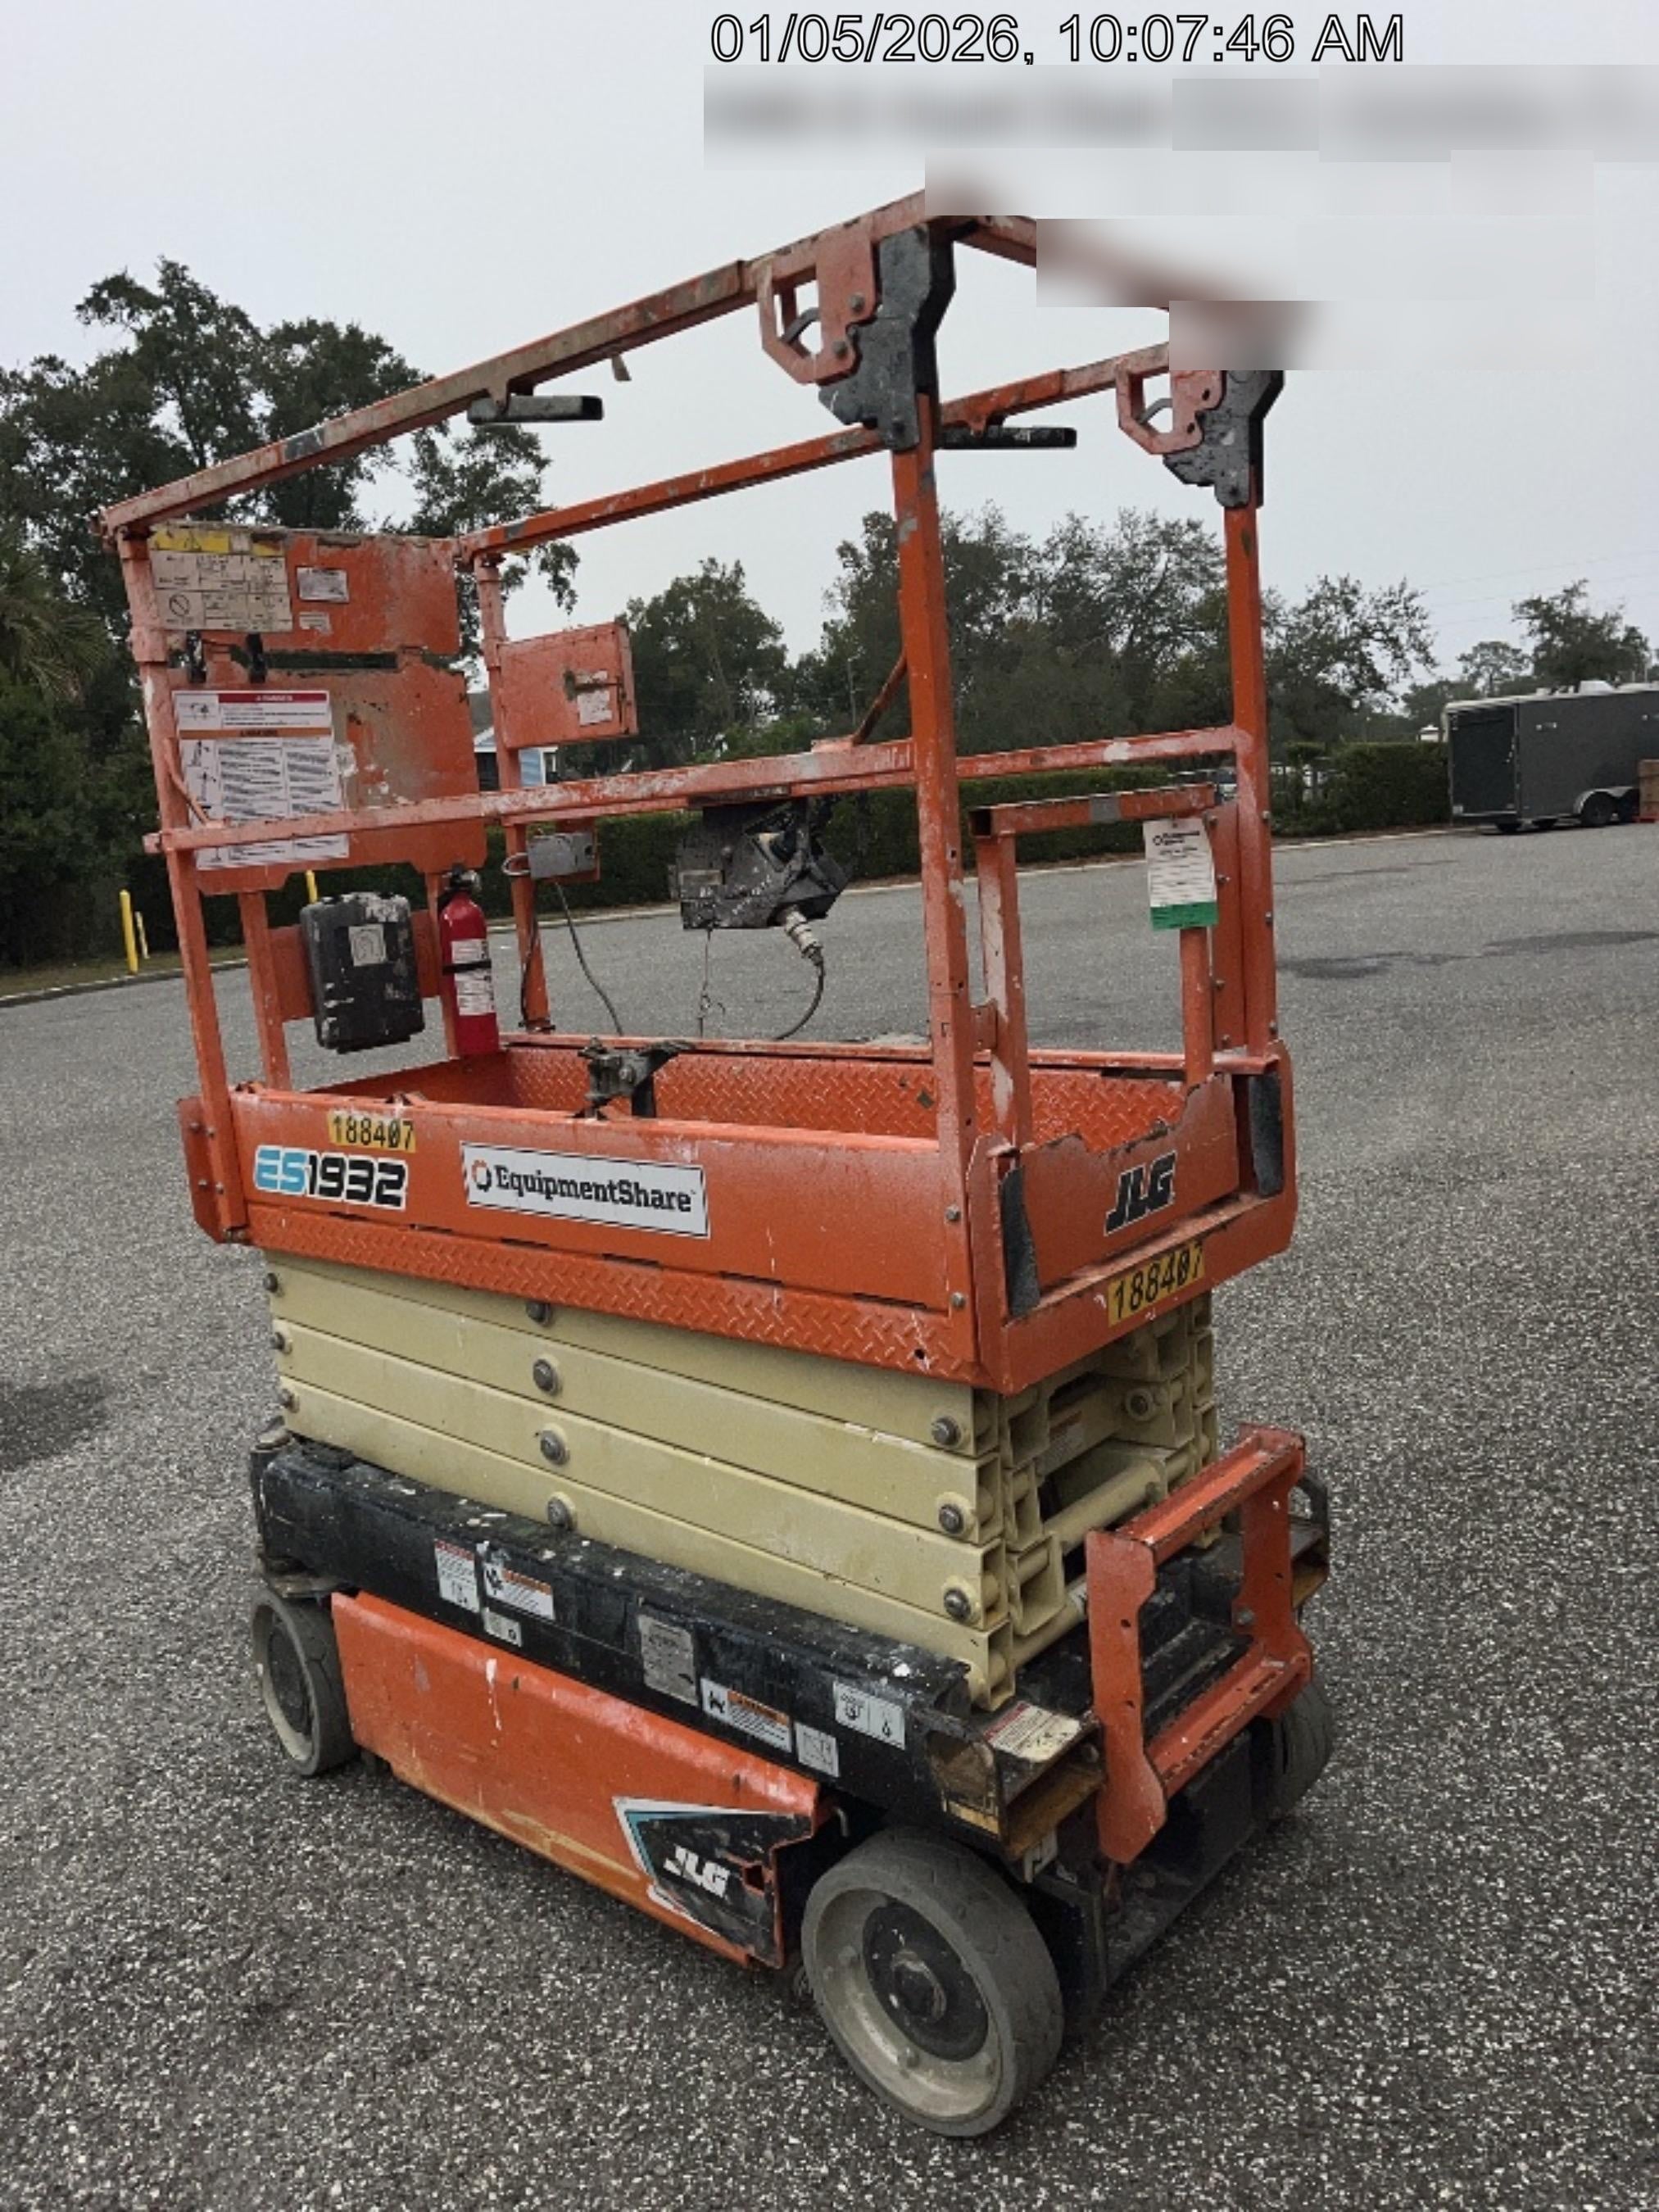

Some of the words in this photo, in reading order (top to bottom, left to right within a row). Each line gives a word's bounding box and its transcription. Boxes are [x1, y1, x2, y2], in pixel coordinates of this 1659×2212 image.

[333, 1115, 414, 1149] 188407
[255, 1147, 407, 1208] ES1932
[494, 1164, 692, 1213] EquipmentShare
[1104, 1150, 1177, 1235] JLG
[663, 1844, 731, 1898] JLG
